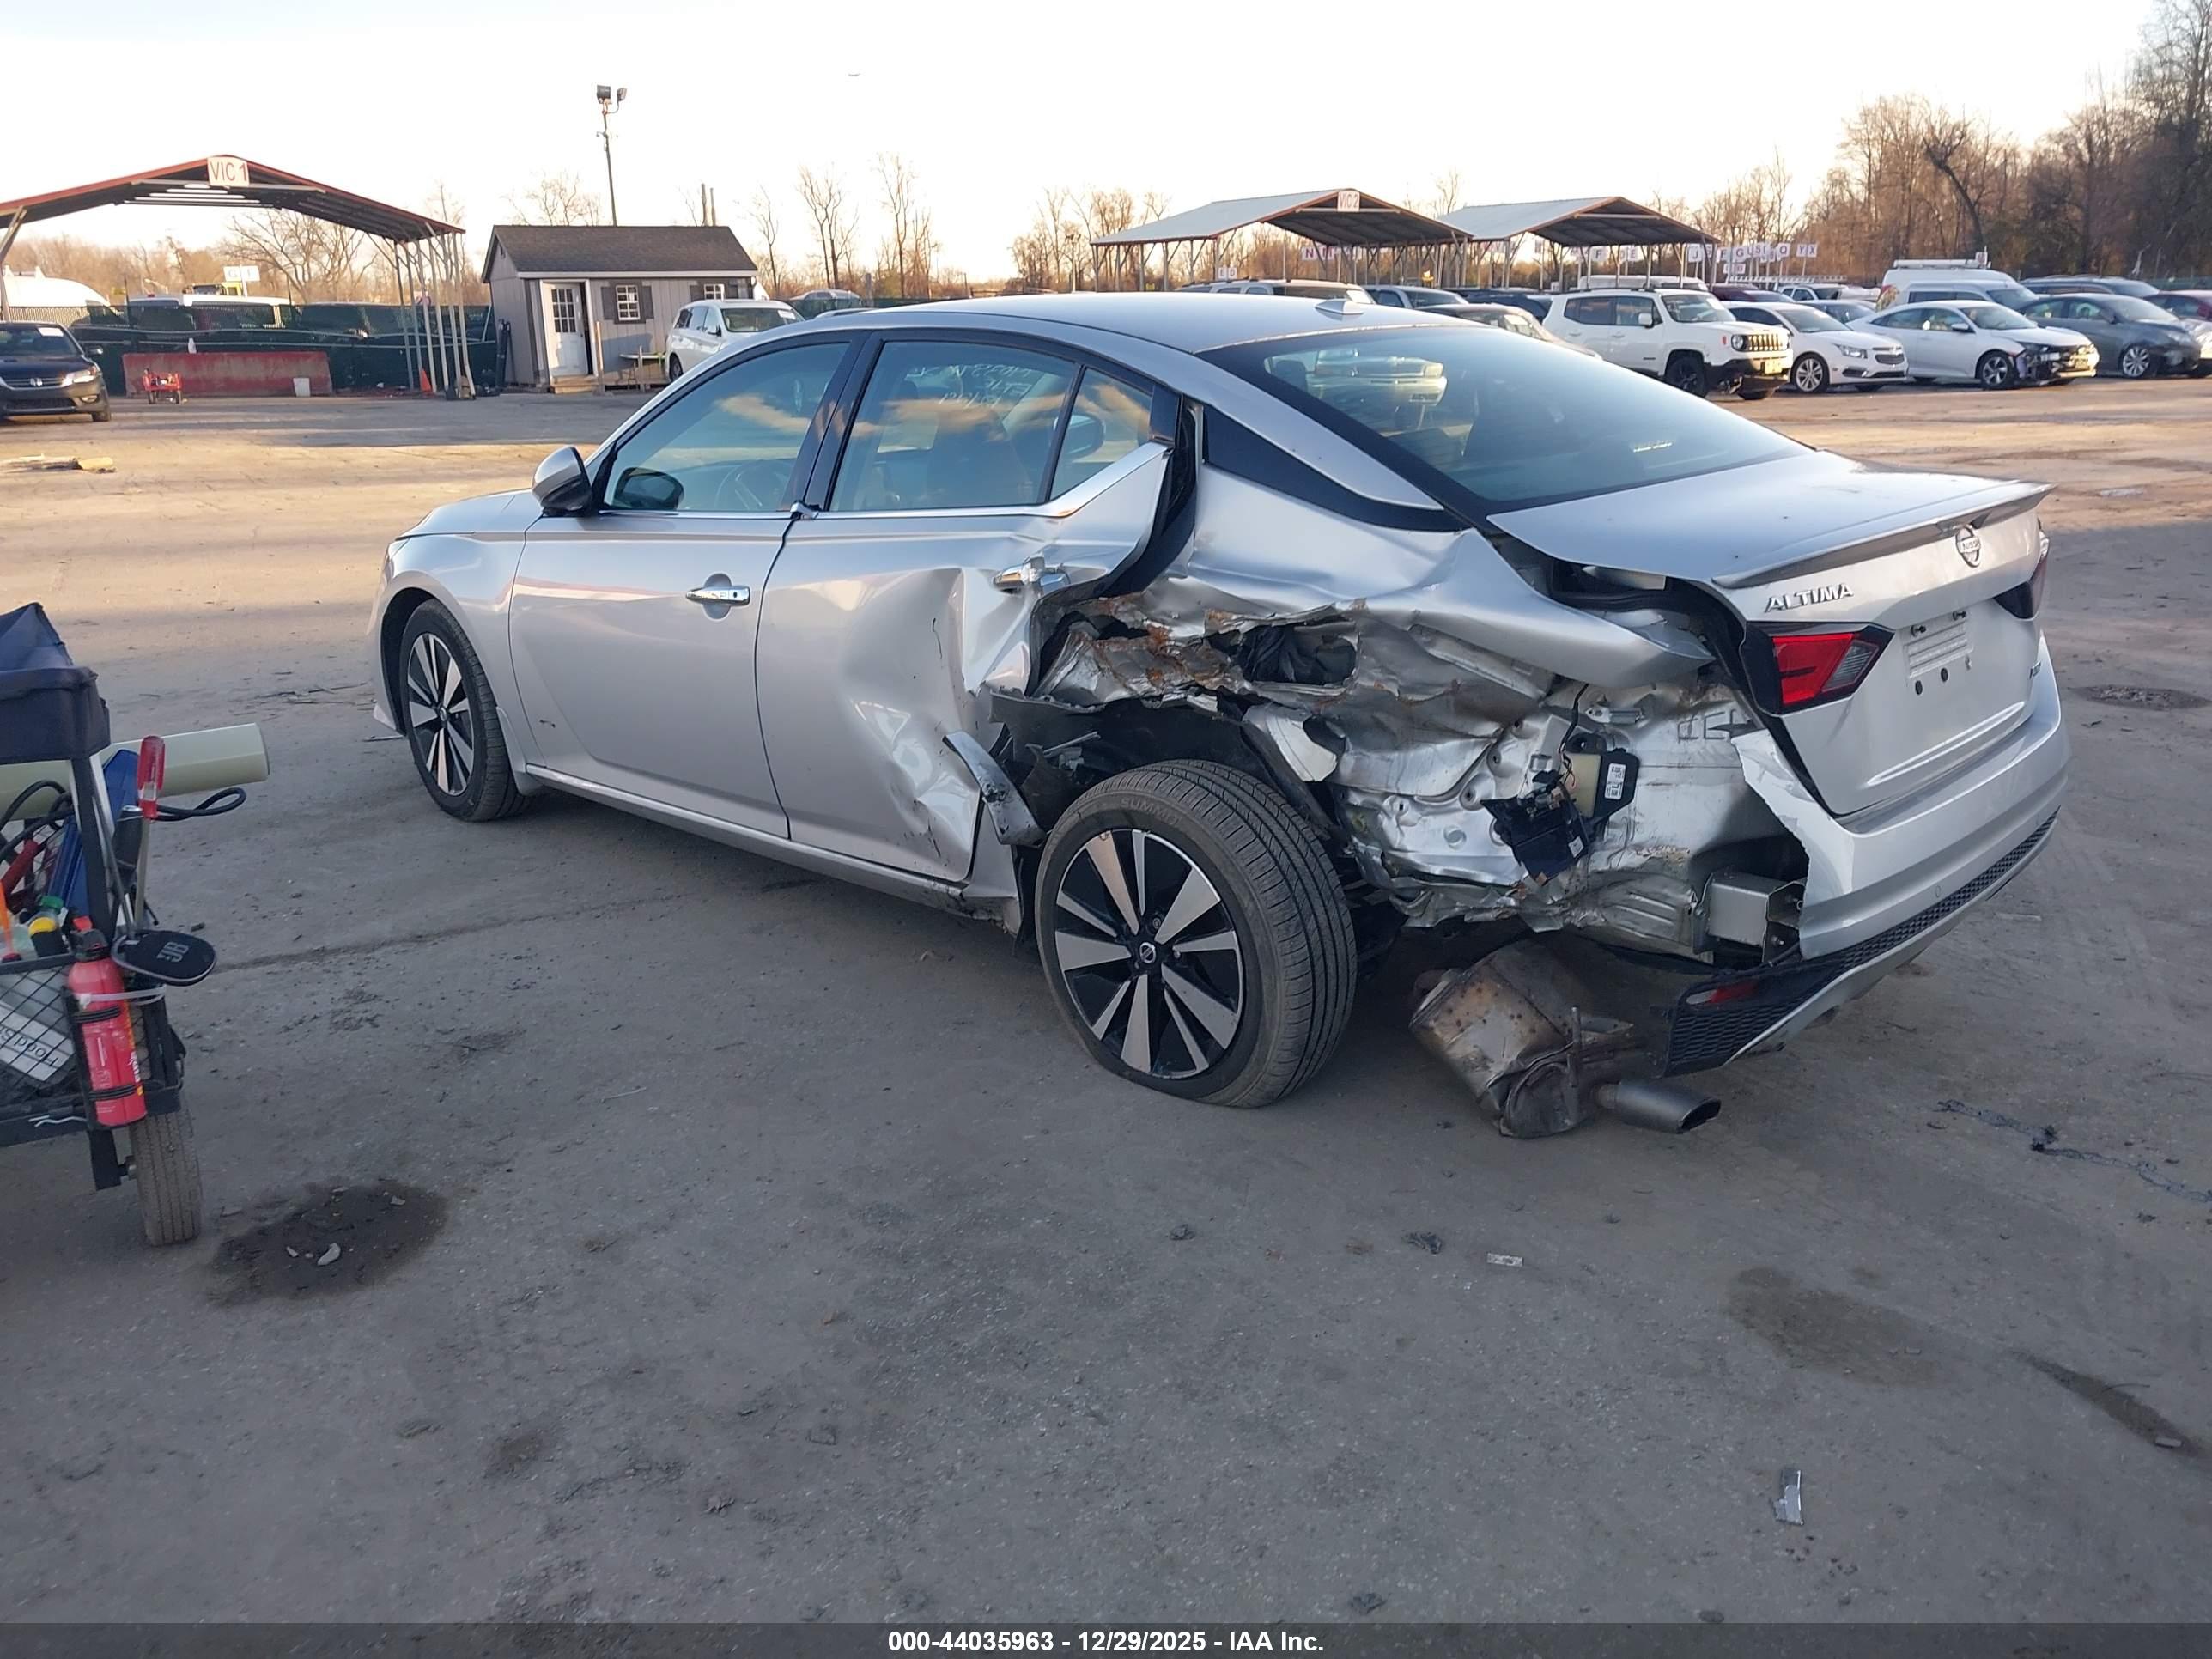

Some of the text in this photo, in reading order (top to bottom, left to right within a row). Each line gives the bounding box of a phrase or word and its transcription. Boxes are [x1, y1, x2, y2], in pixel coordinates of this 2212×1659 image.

[210, 161, 247, 182] VIC 1
[1305, 247, 1315, 258] N
[1764, 583, 1854, 613] ALTIMA
